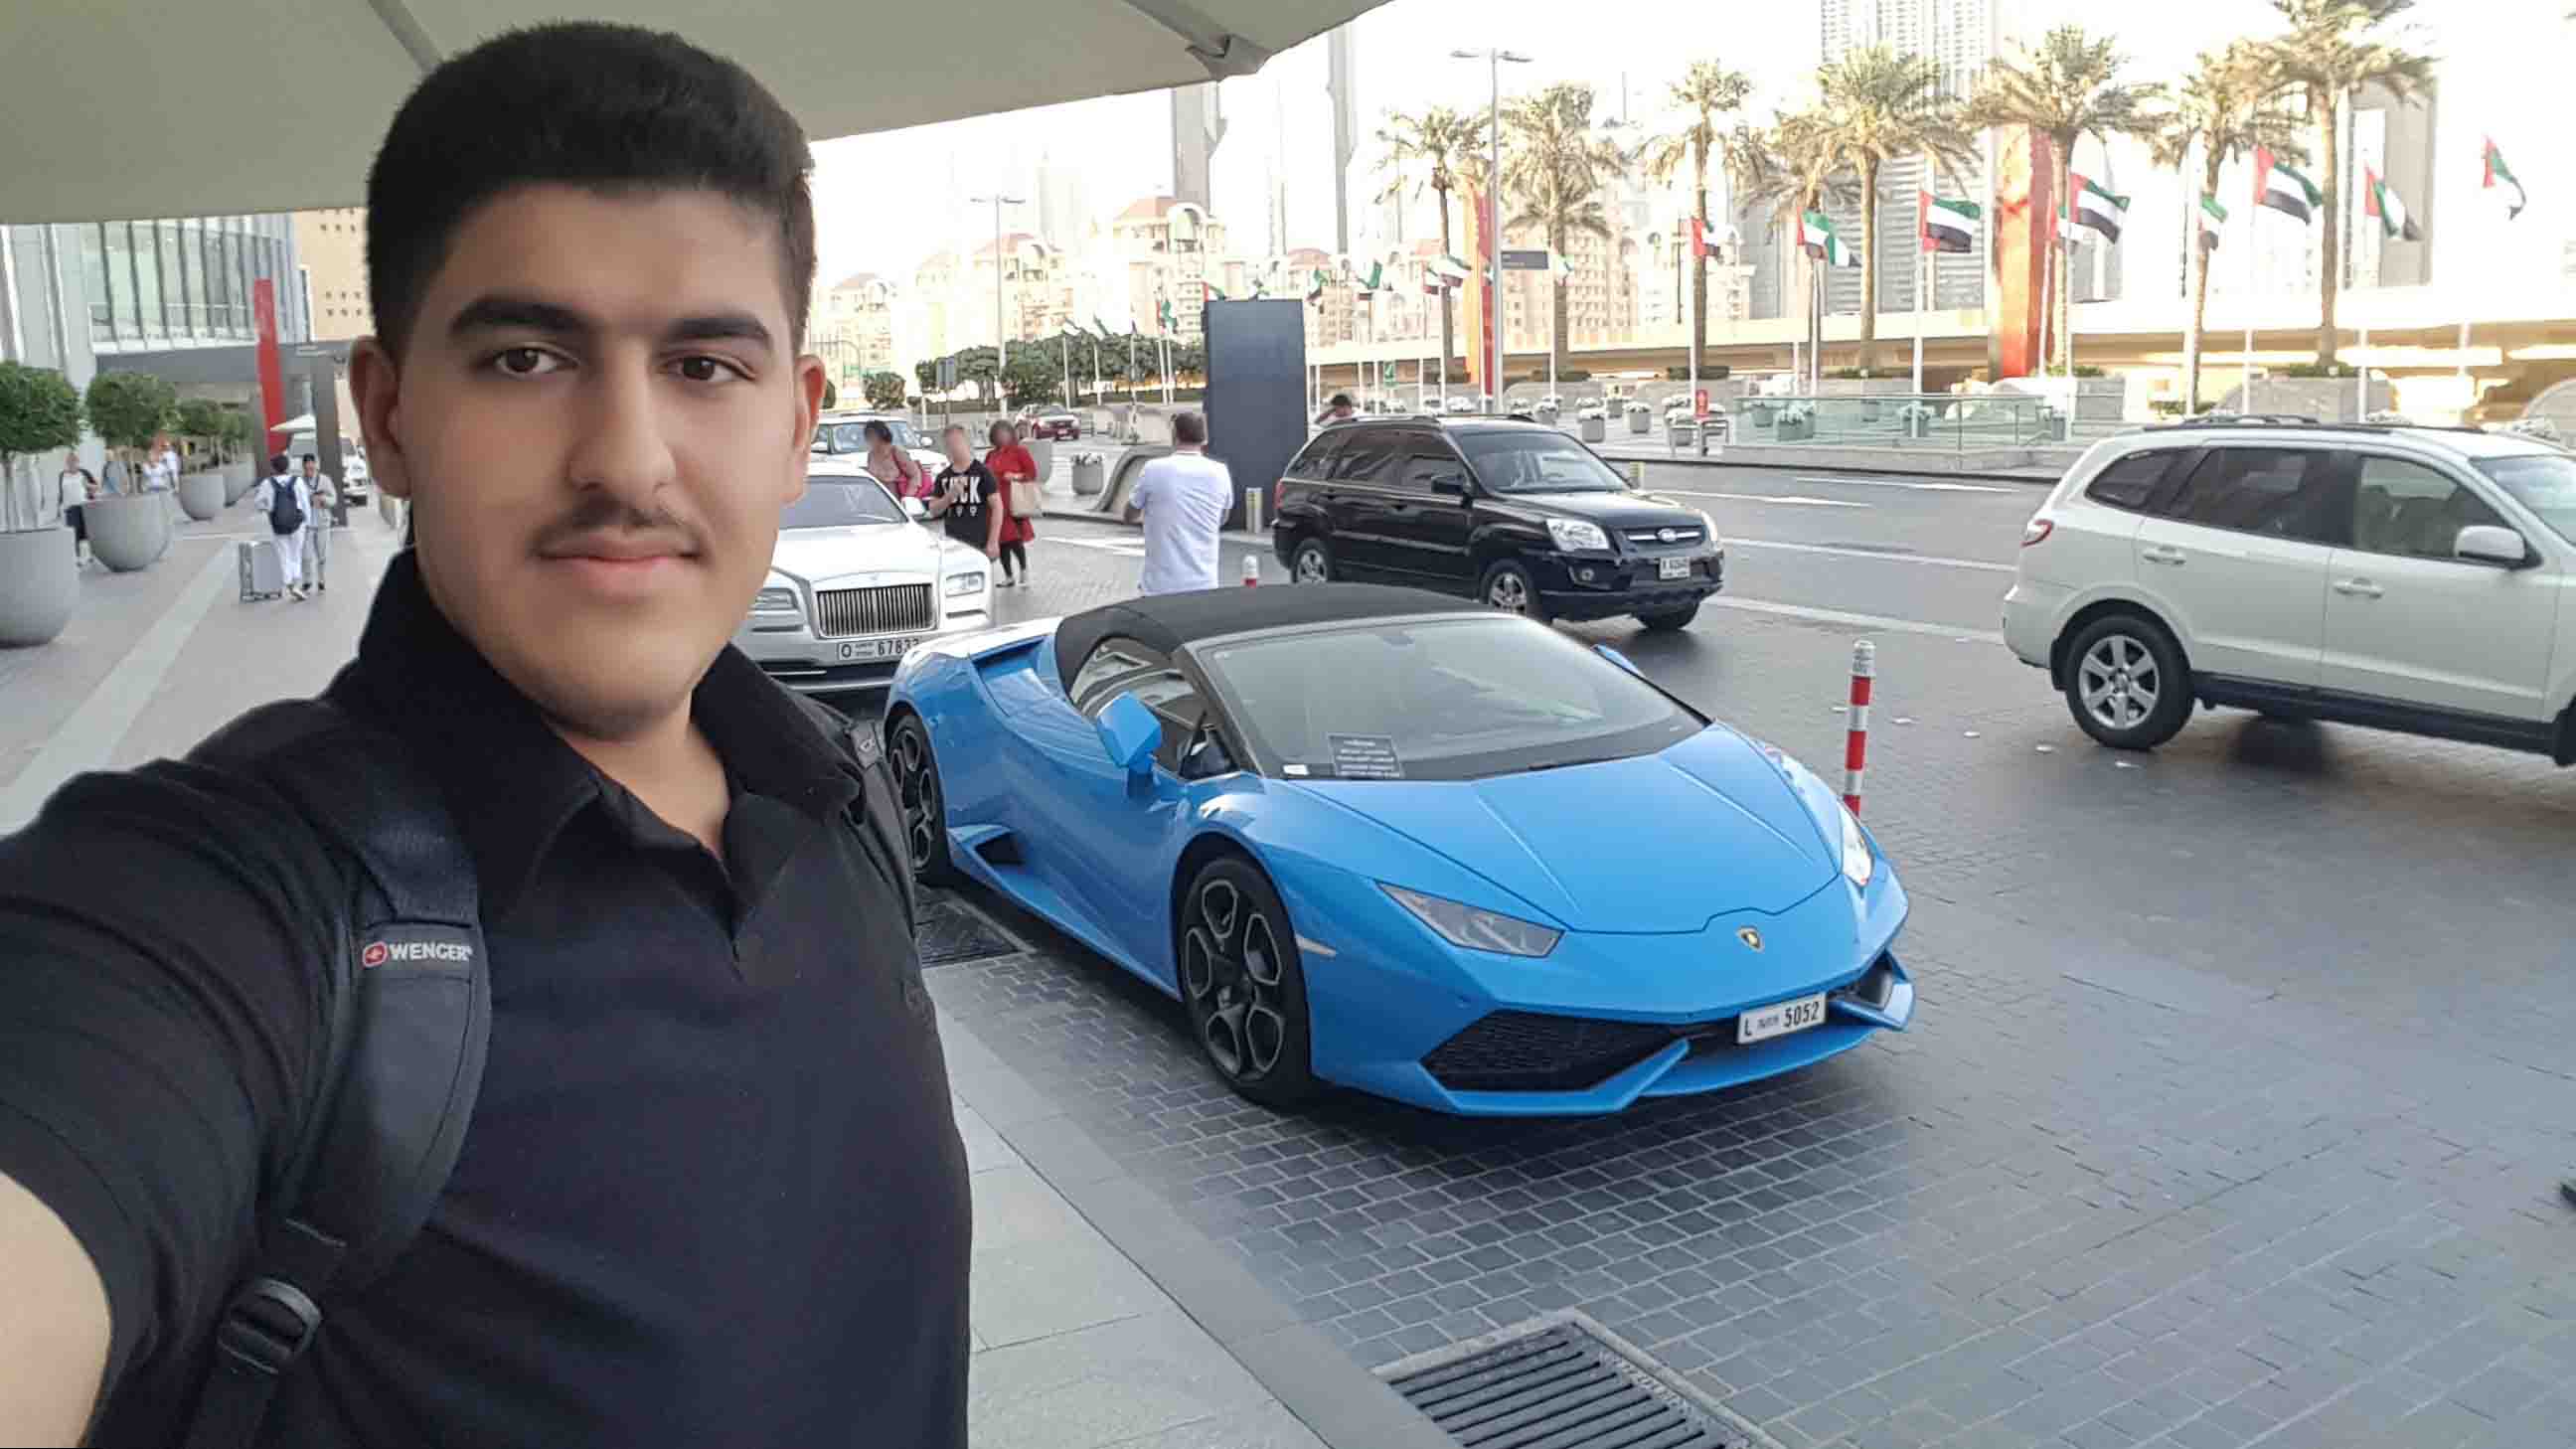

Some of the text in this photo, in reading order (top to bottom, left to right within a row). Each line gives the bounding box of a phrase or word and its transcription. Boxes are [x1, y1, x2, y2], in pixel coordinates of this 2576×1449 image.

[389, 942, 473, 961] WENGER
[1744, 1018, 1752, 1037] L
[1783, 1001, 1820, 1029] 5052
